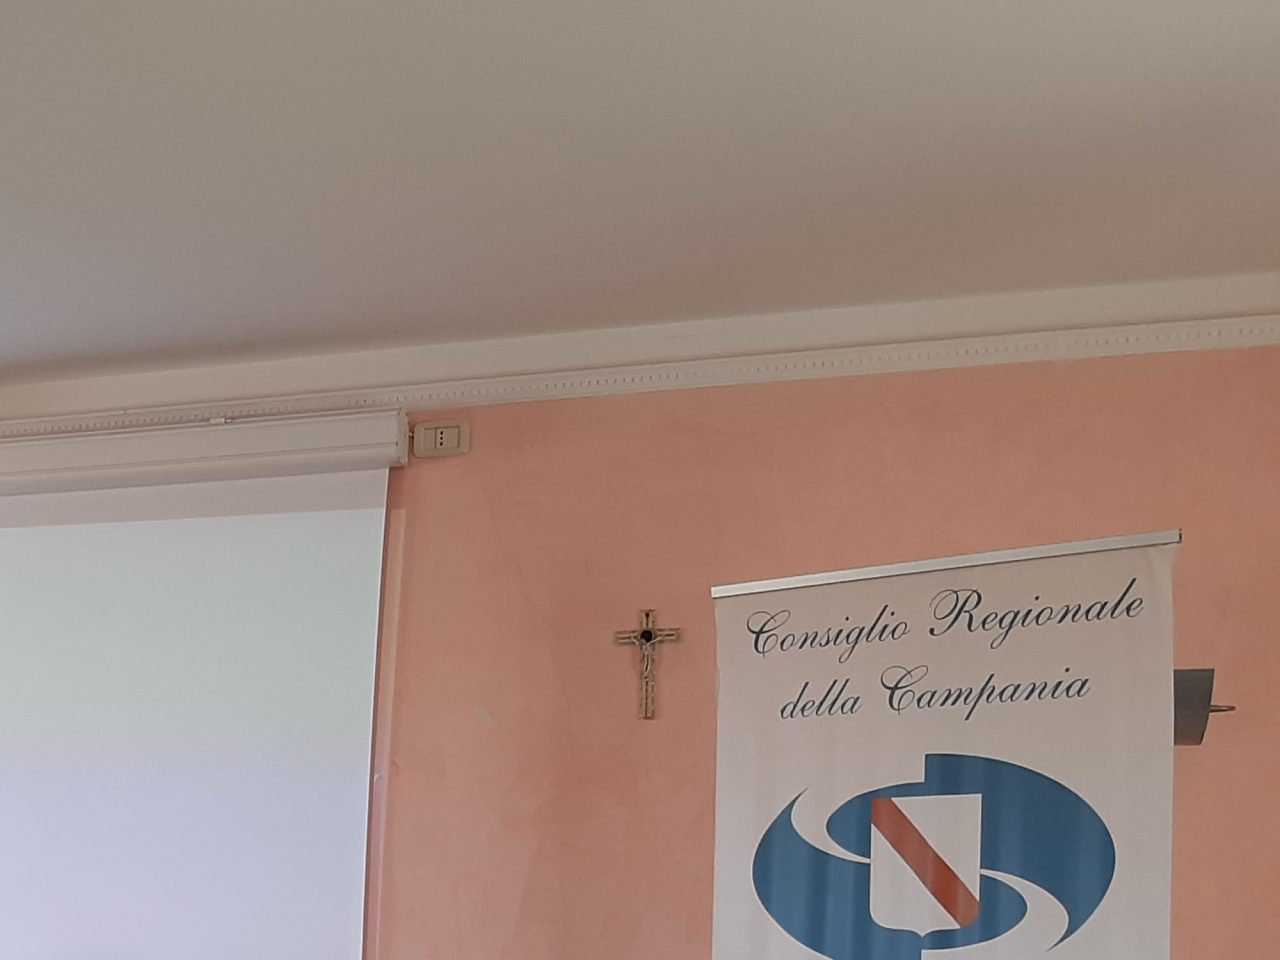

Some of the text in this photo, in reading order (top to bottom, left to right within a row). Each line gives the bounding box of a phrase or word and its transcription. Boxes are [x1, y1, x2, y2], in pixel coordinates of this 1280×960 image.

[746, 577, 1144, 663] Consiglio Regionale
[779, 664, 1091, 720] della Campania
